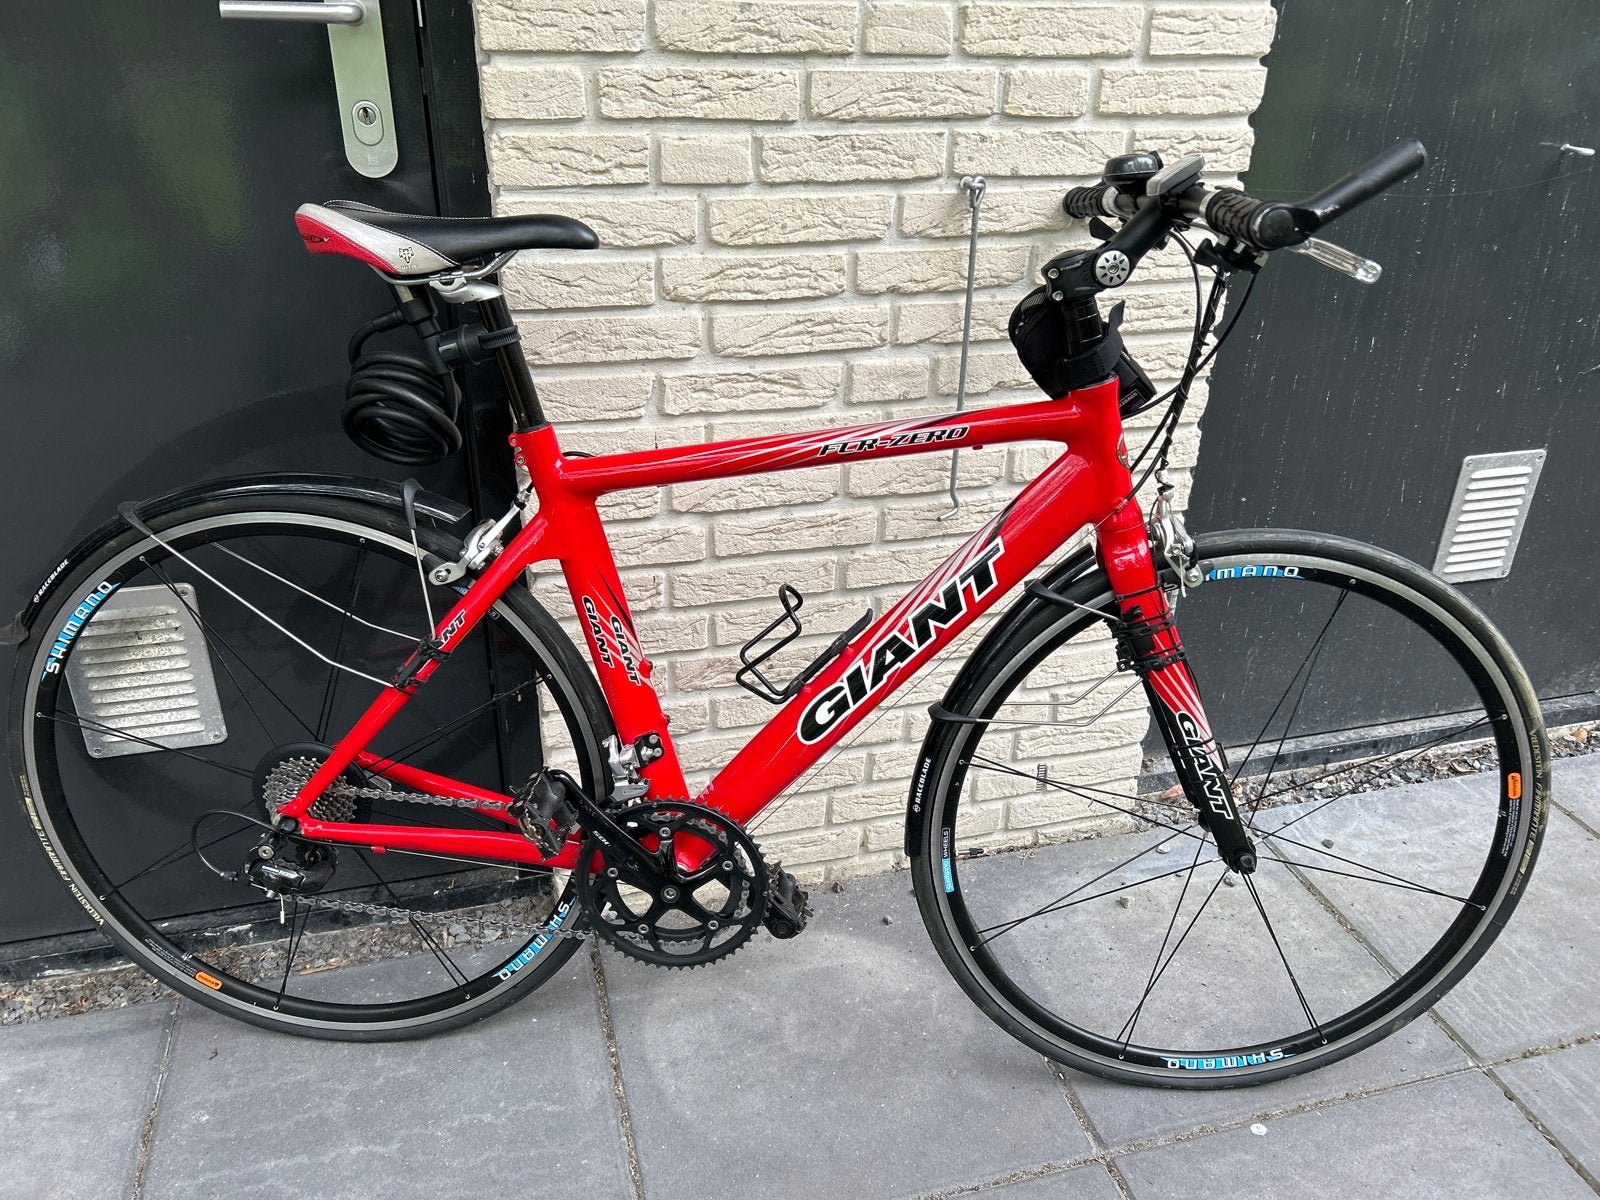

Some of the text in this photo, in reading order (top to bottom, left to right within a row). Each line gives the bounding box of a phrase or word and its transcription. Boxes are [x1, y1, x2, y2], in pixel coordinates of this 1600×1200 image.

[817, 426, 970, 457] FCR-ZERO
[38, 558, 69, 597] RACEBLADE
[46, 581, 113, 674] SHIMANO
[582, 596, 615, 668] GIANT
[610, 615, 641, 686] GIANT
[797, 535, 1005, 745] GIANT
[915, 757, 932, 804] RACEBLADE
[1176, 711, 1235, 820] GIANT
[1529, 728, 1543, 779] VREDESTEIN
[69, 883, 104, 926] VREDESTEIN
[499, 901, 570, 981] SHMANO
[1167, 1048, 1284, 1070] SHIMANO
